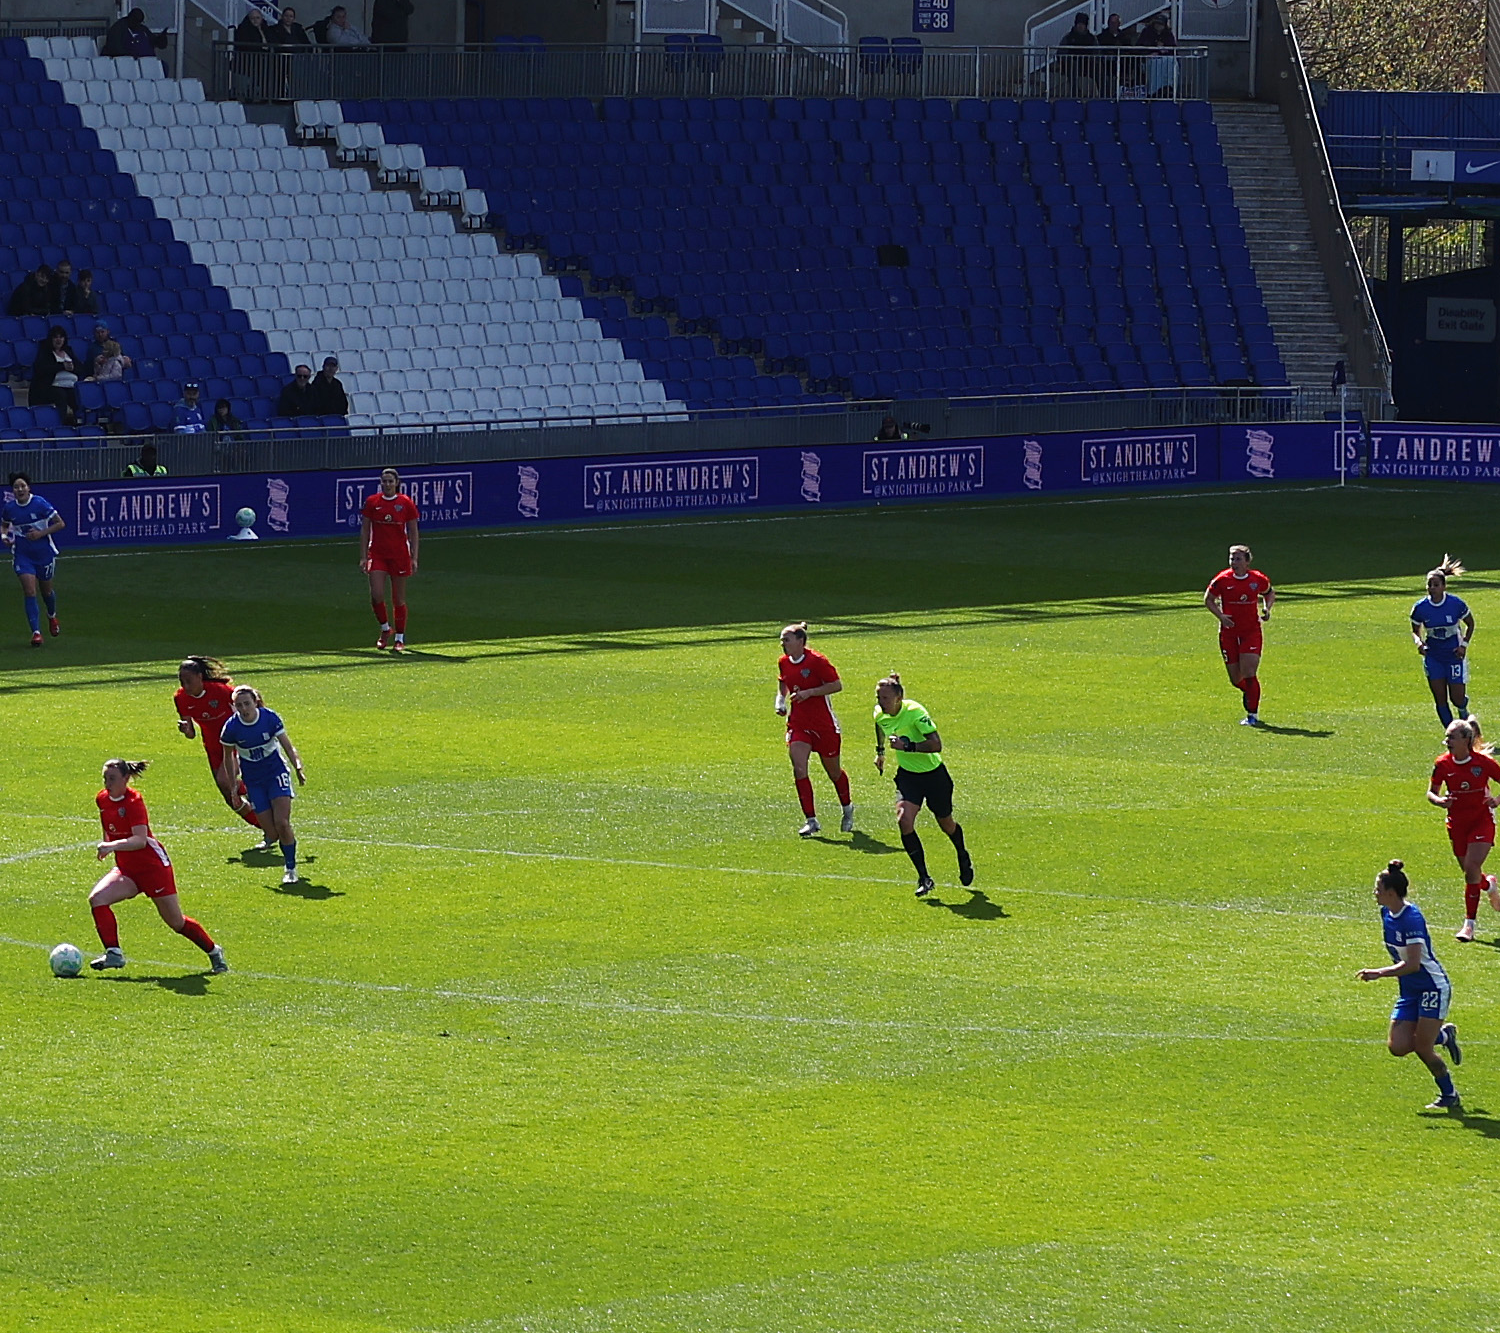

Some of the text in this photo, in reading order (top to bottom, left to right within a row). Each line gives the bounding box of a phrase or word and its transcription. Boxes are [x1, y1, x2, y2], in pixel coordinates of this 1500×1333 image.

[933, 13, 948, 28] 38
[1438, 320, 1456, 330] Exit
[1163, 467, 1187, 481] PARK
[948, 481, 973, 494] PARK
[722, 493, 746, 504] PARK
[432, 508, 458, 521] PARK
[177, 521, 206, 535] PARK
[1421, 991, 1440, 1008] 22
